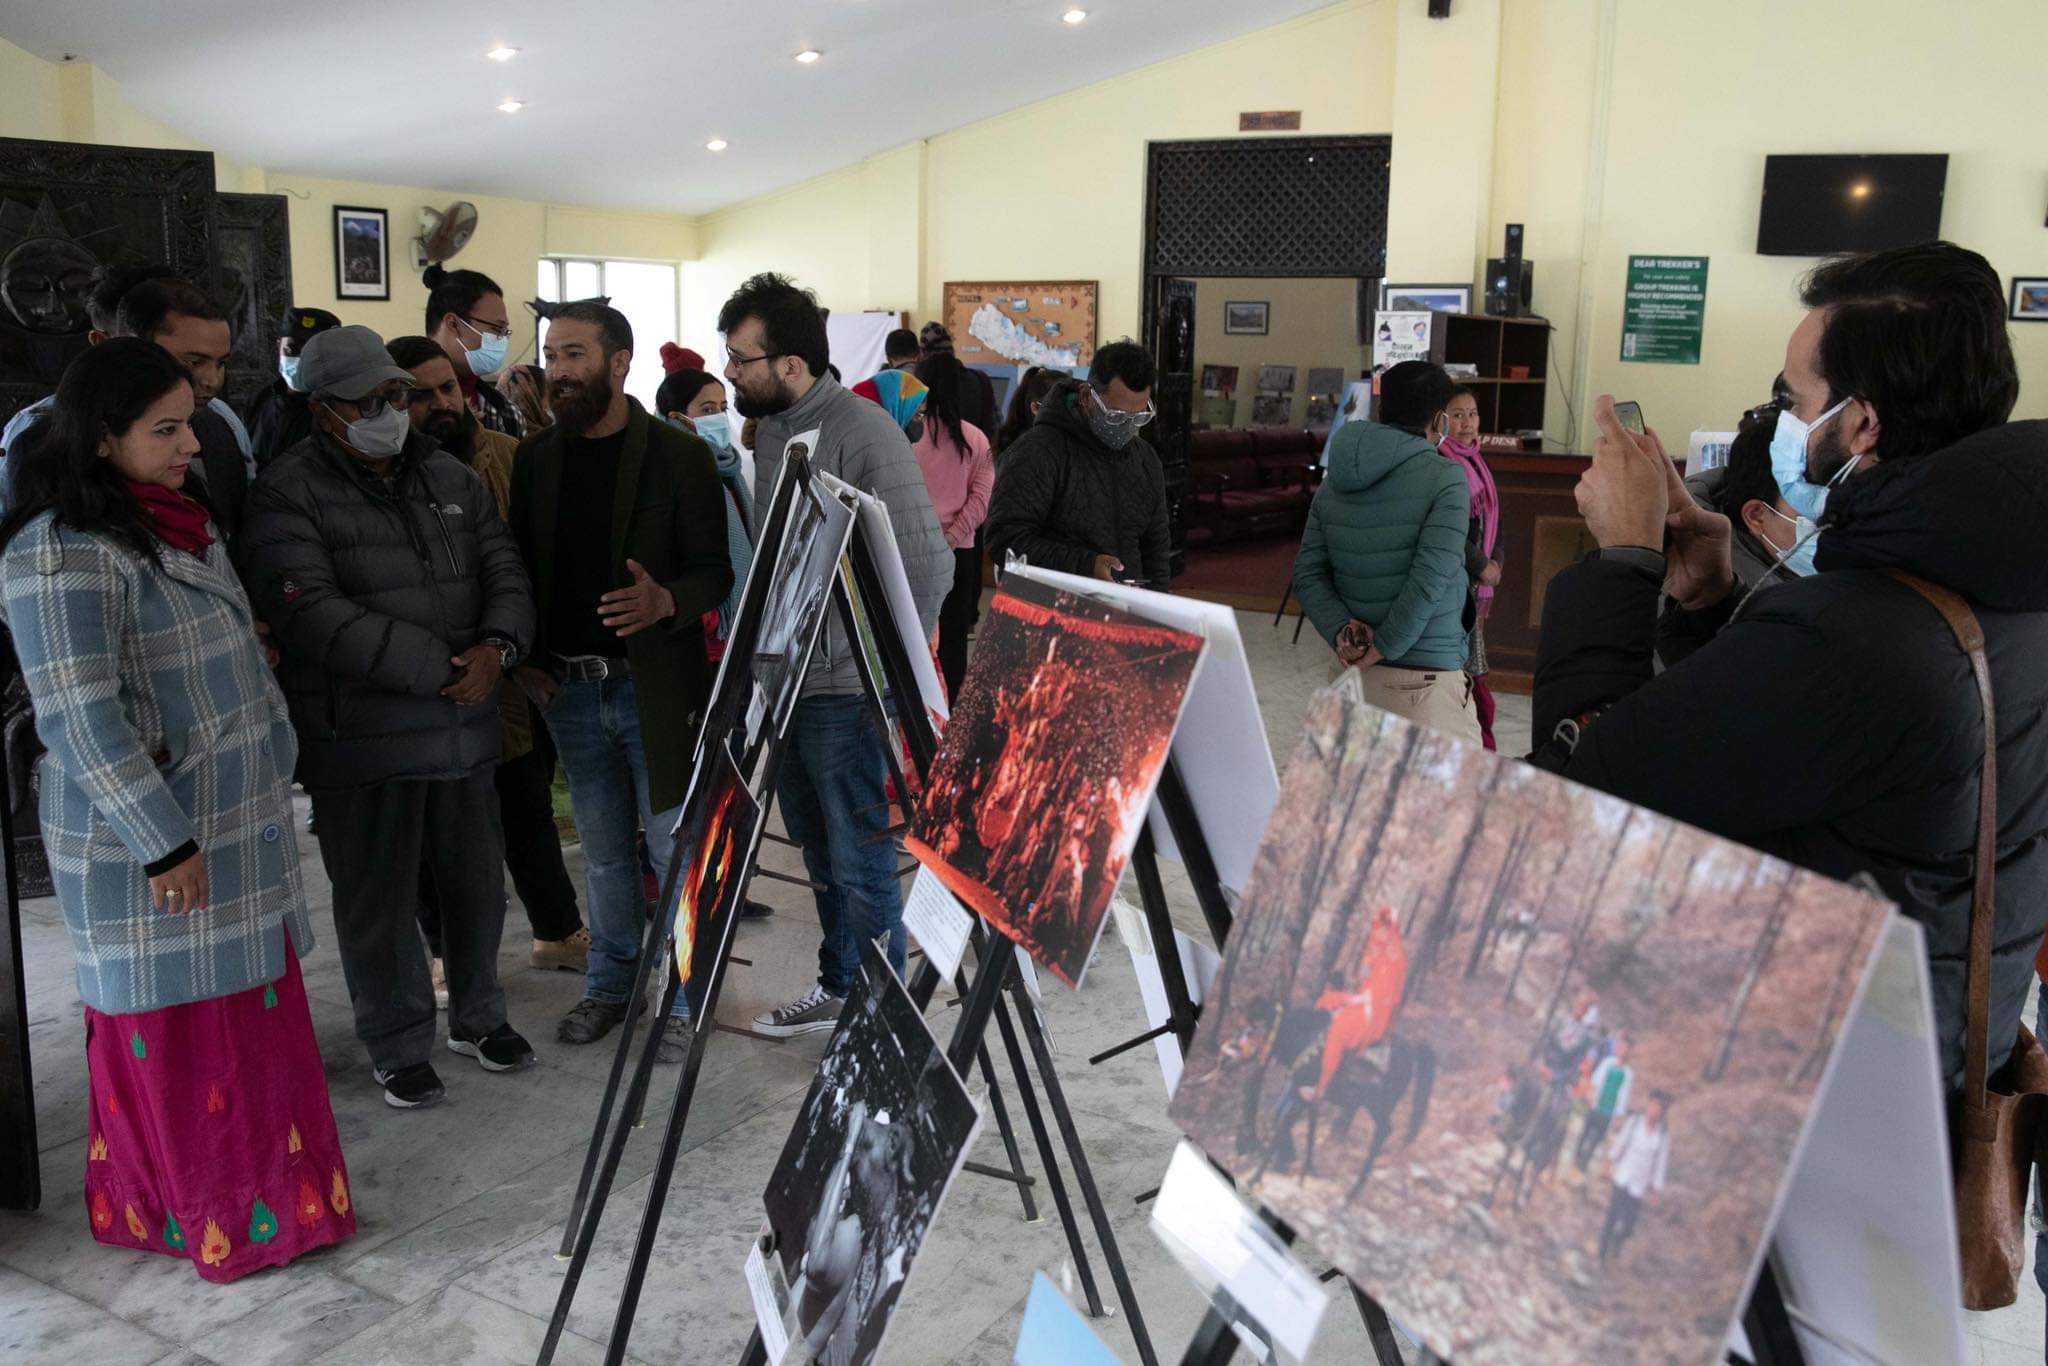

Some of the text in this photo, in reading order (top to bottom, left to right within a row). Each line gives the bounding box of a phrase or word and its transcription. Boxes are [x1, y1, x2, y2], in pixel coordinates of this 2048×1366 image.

[1633, 259, 1655, 268] DEAR
[1634, 283, 1657, 291] GROUP
[1658, 284, 1690, 292] TREKKING
[1628, 291, 1703, 301] HIGHLY RECOMMENDED
[1490, 436, 1519, 447] DESK
